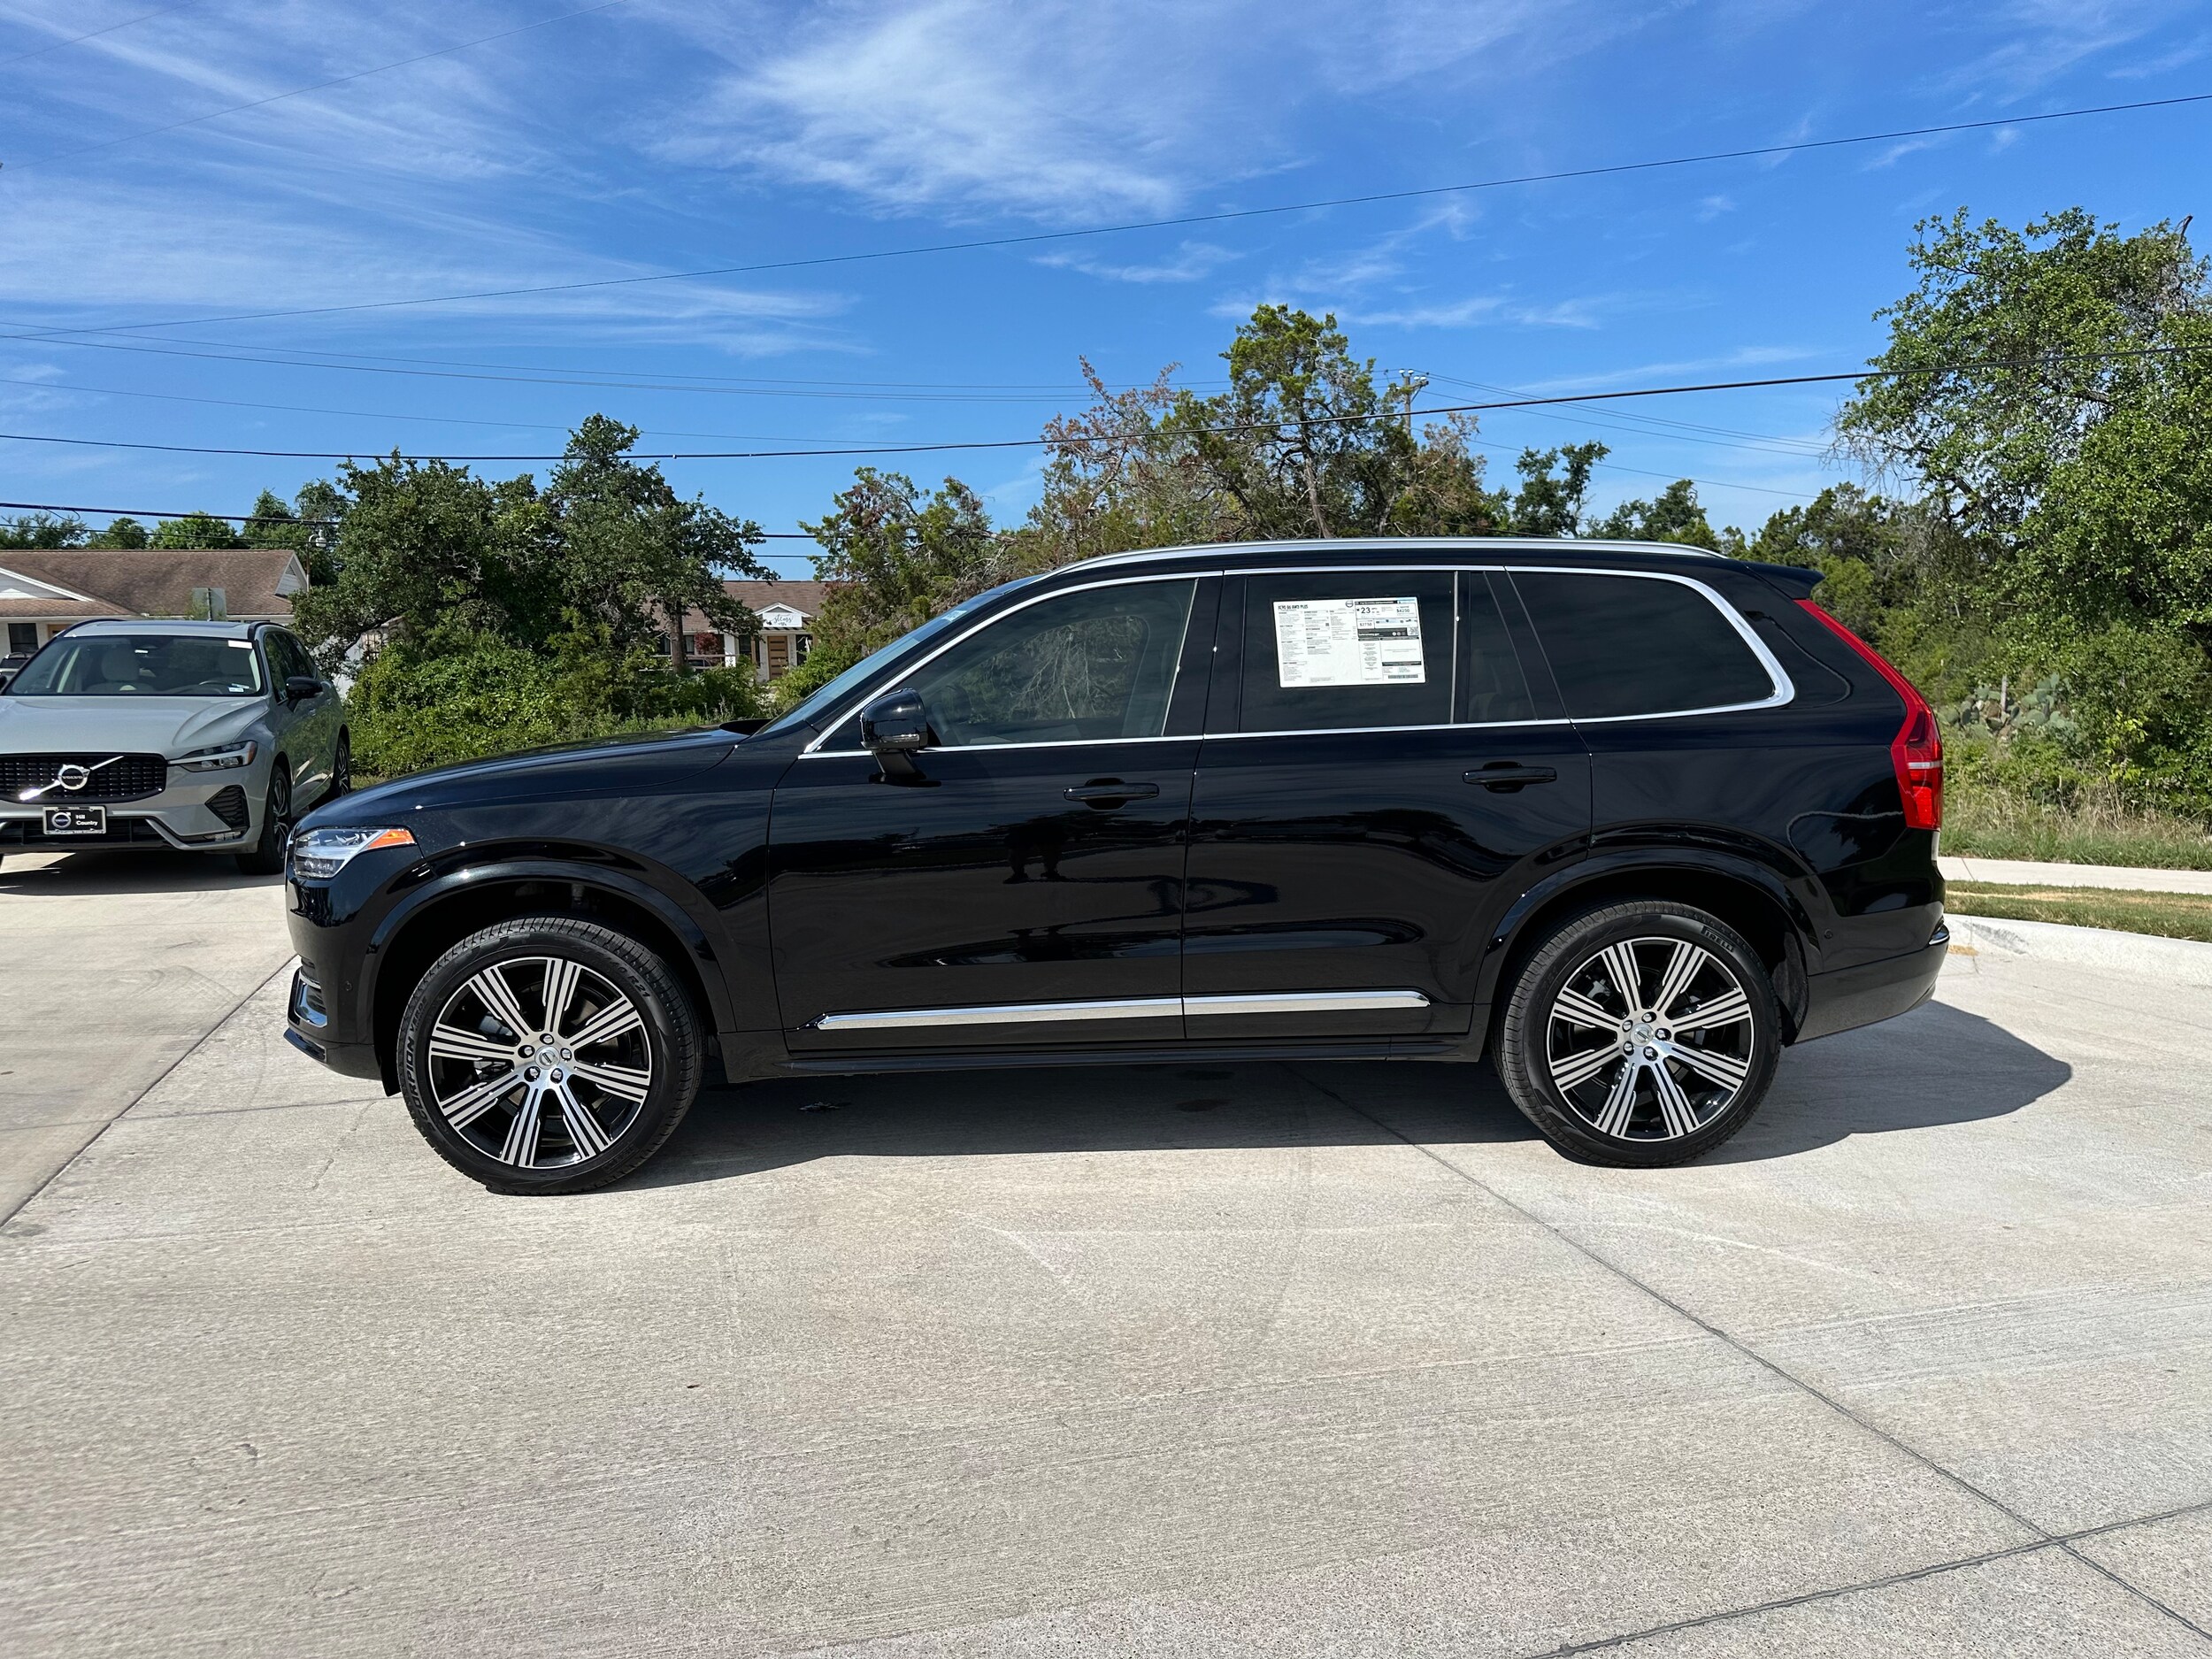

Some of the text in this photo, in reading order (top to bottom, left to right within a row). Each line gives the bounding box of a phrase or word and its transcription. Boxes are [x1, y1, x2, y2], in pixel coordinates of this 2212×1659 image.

[1701, 925, 1734, 952] PIRELLI
[627, 975, 650, 997] R21
[409, 995, 426, 1033] VERDE
[406, 1036, 435, 1131] SCORPION
